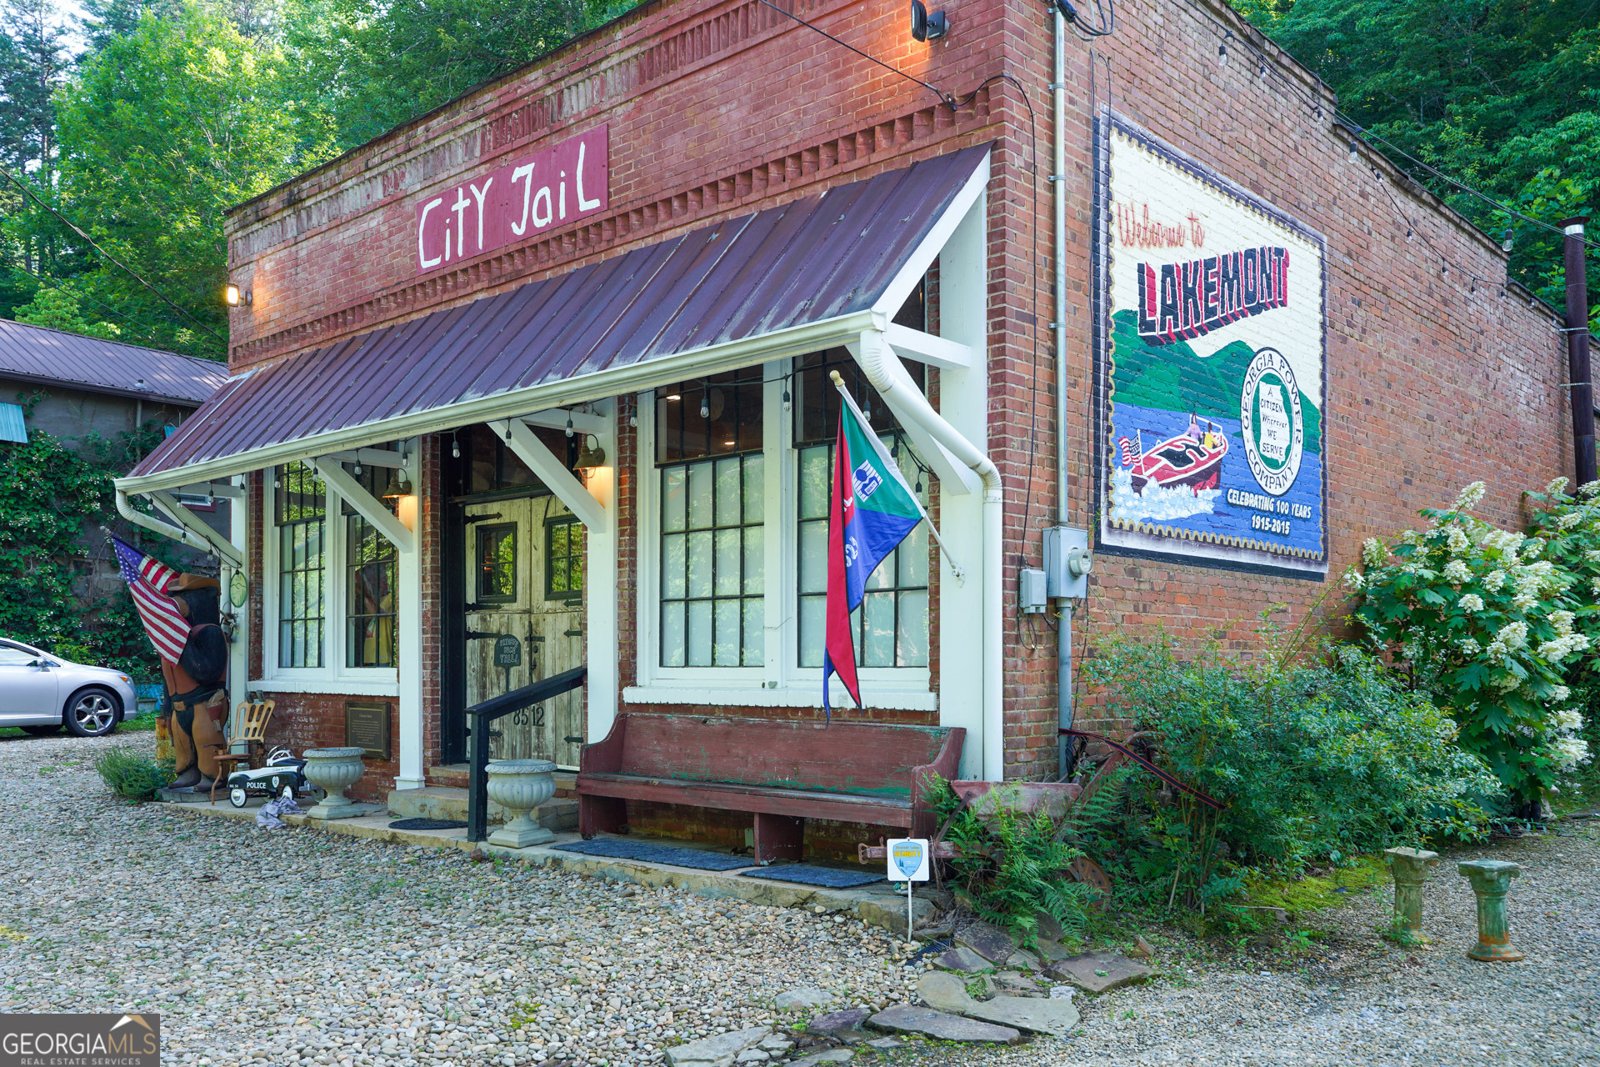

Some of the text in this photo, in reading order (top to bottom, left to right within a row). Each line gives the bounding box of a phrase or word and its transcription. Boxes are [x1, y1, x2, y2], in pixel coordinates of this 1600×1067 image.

[1117, 201, 1205, 248] Welcome to
[1137, 246, 1289, 343] LAKEMONT
[1243, 353, 1302, 444] GEORGIA POWER
[1267, 387, 1274, 397] A
[1260, 398, 1283, 413] CITIZEN
[1267, 429, 1278, 440] WE
[1262, 442, 1284, 457] SERVE
[1248, 449, 1294, 489] COMPANY
[1227, 488, 1312, 519] CELEBRATING 100 YEARS
[1251, 514, 1291, 536] 1915-2015
[513, 705, 545, 727] 8512
